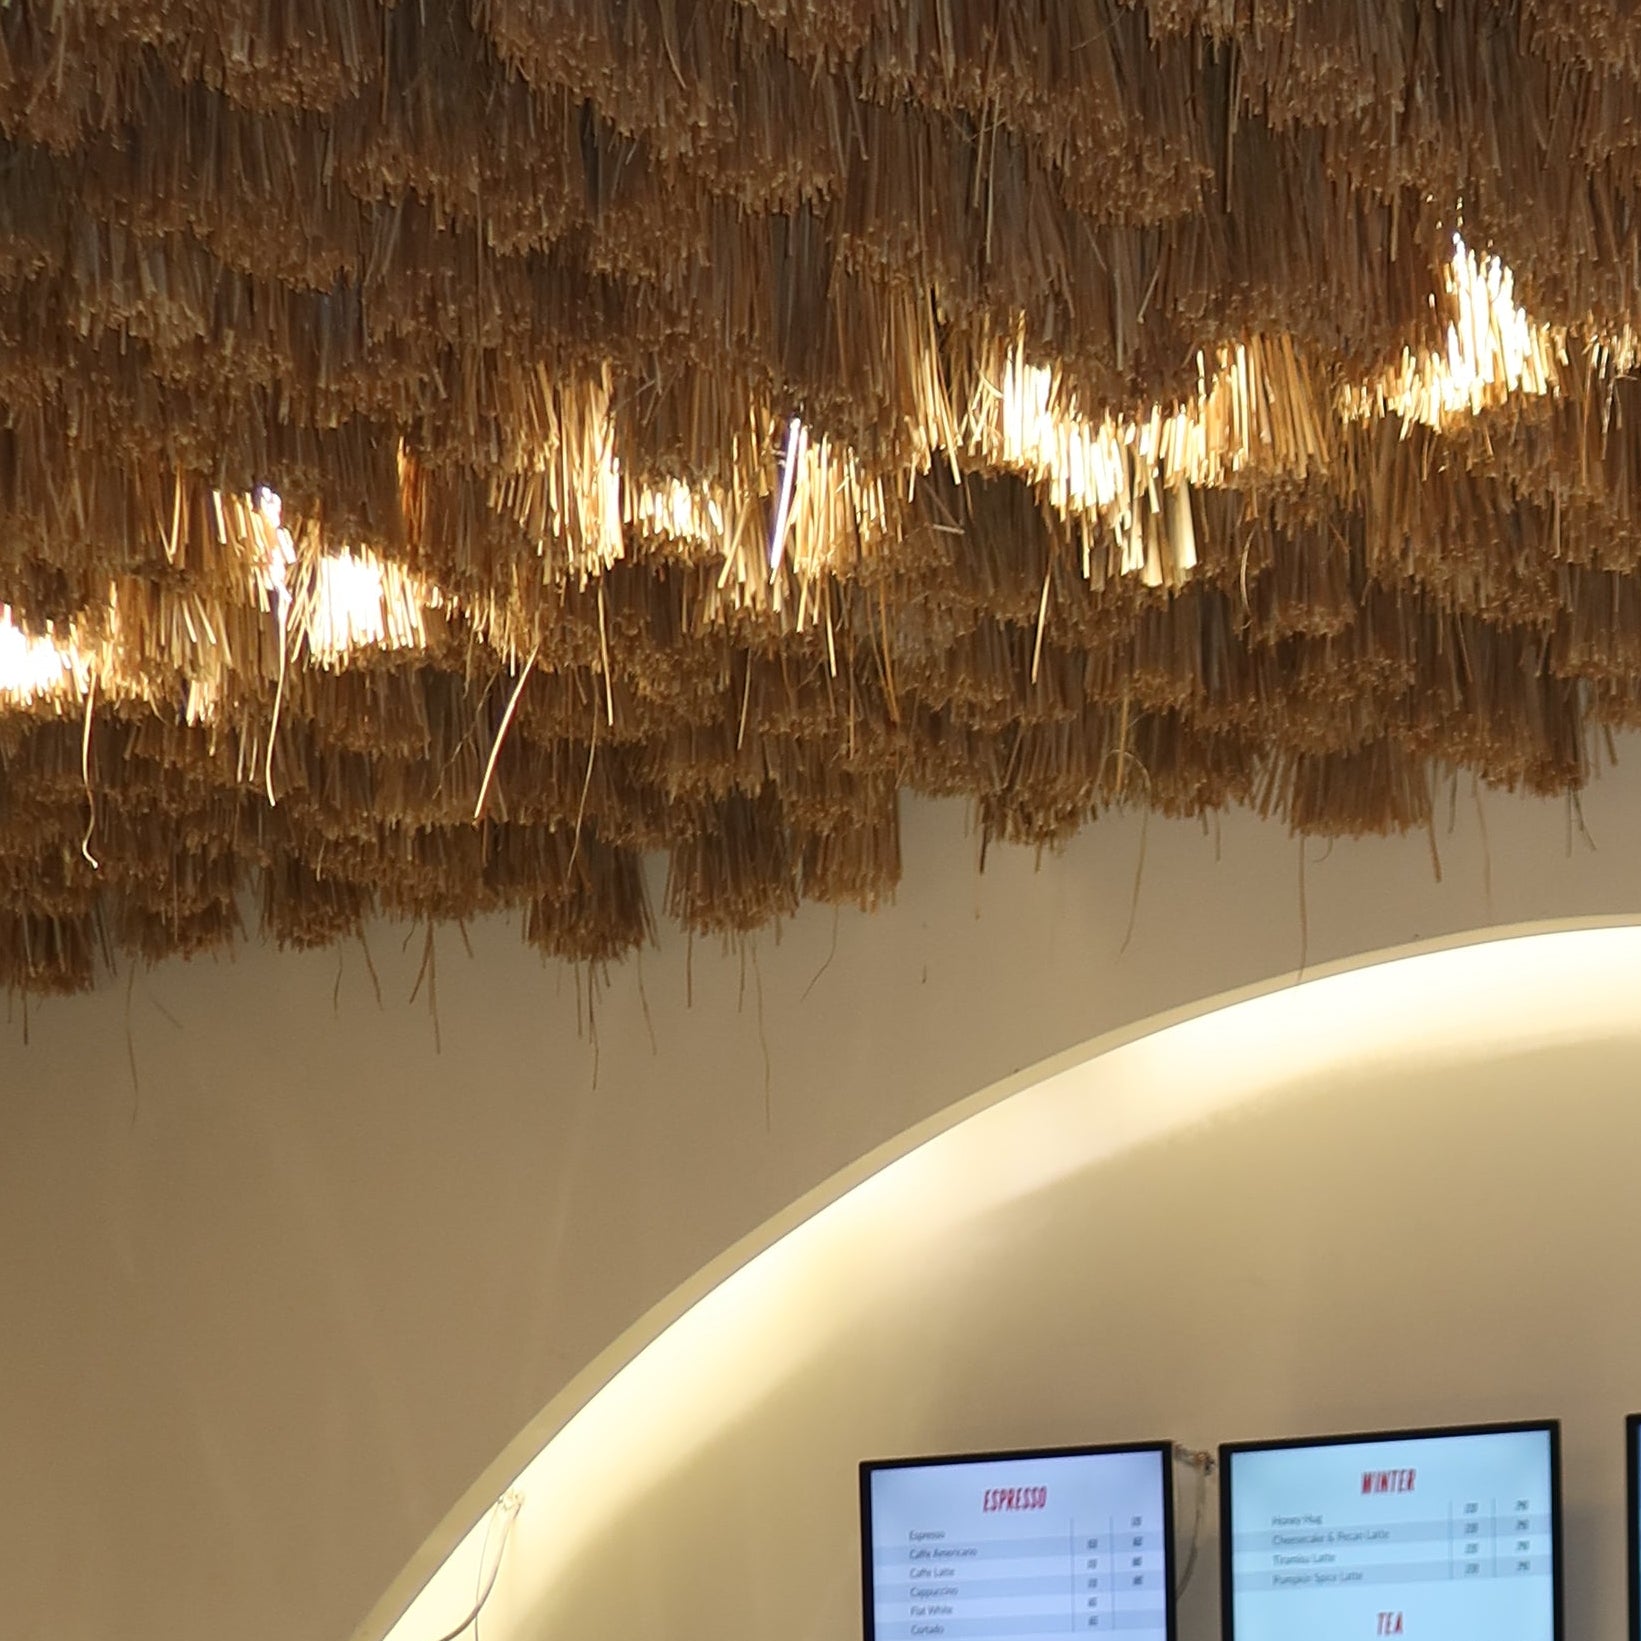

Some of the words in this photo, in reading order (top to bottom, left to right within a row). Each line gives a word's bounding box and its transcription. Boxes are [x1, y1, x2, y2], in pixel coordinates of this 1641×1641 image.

[1361, 1469, 1416, 1495] WINTER
[983, 1486, 1047, 1512] ESPRESSO
[1377, 1611, 1402, 1636] TEA
